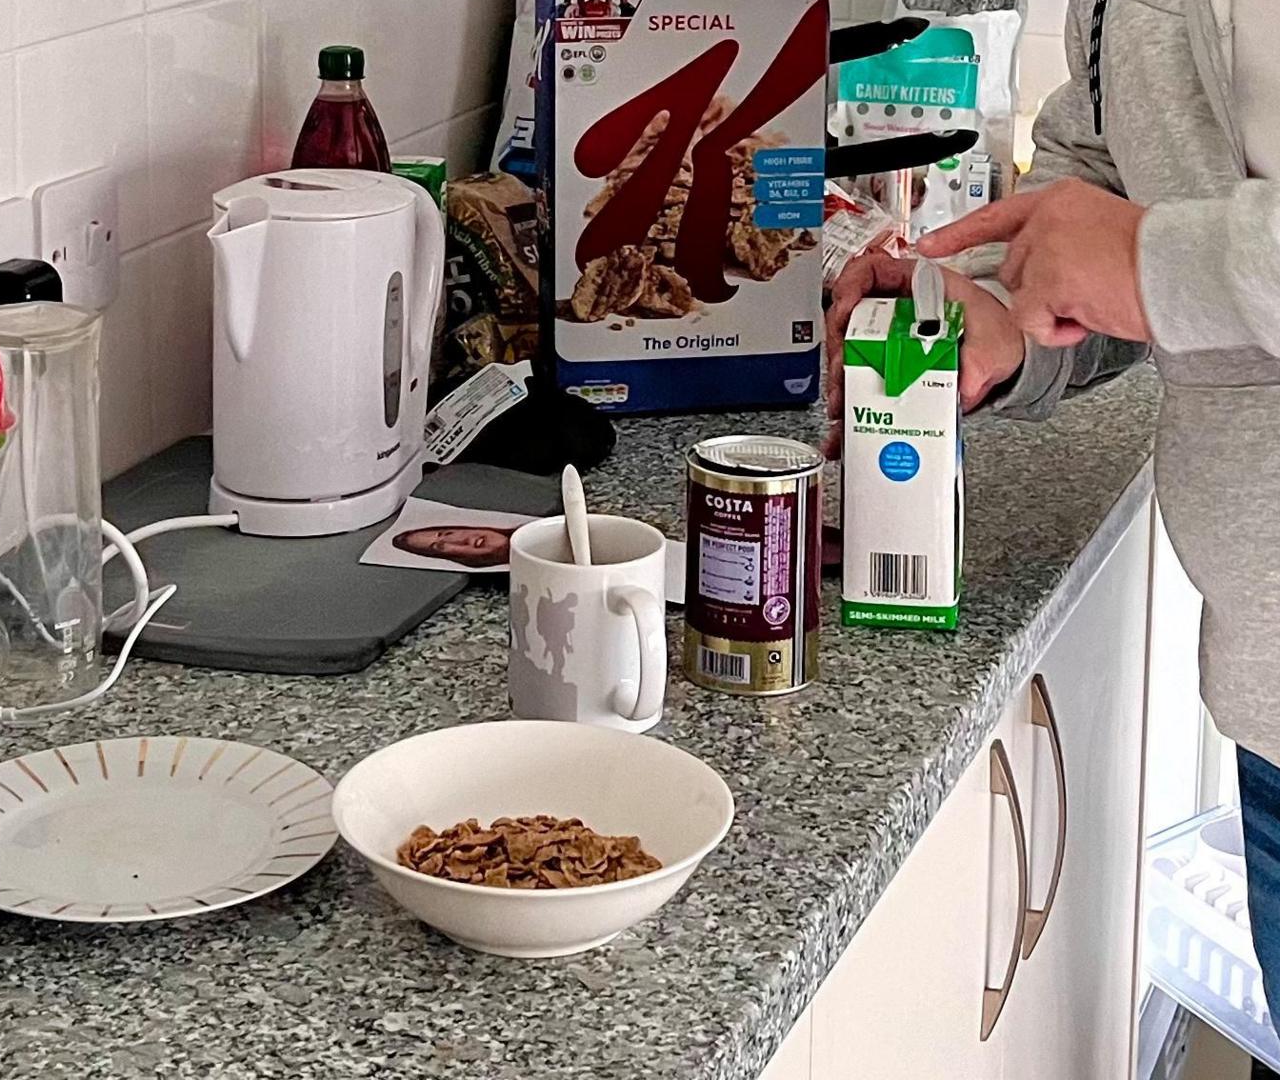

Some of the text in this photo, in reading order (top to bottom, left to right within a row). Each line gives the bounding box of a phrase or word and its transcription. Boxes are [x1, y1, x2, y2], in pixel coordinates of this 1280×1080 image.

[648, 14, 736, 32] SPECIAL
[855, 83, 957, 104] CANDY KITTENS
[642, 333, 740, 351] The Original
[927, 380, 945, 388] Litre
[852, 405, 894, 426] Viva
[853, 426, 946, 438] SEMI-SKIMMED MILK
[705, 493, 754, 513] COSTA
[713, 510, 742, 521] COFFEE
[848, 610, 947, 624] SEMI-SKIMMED MILK
